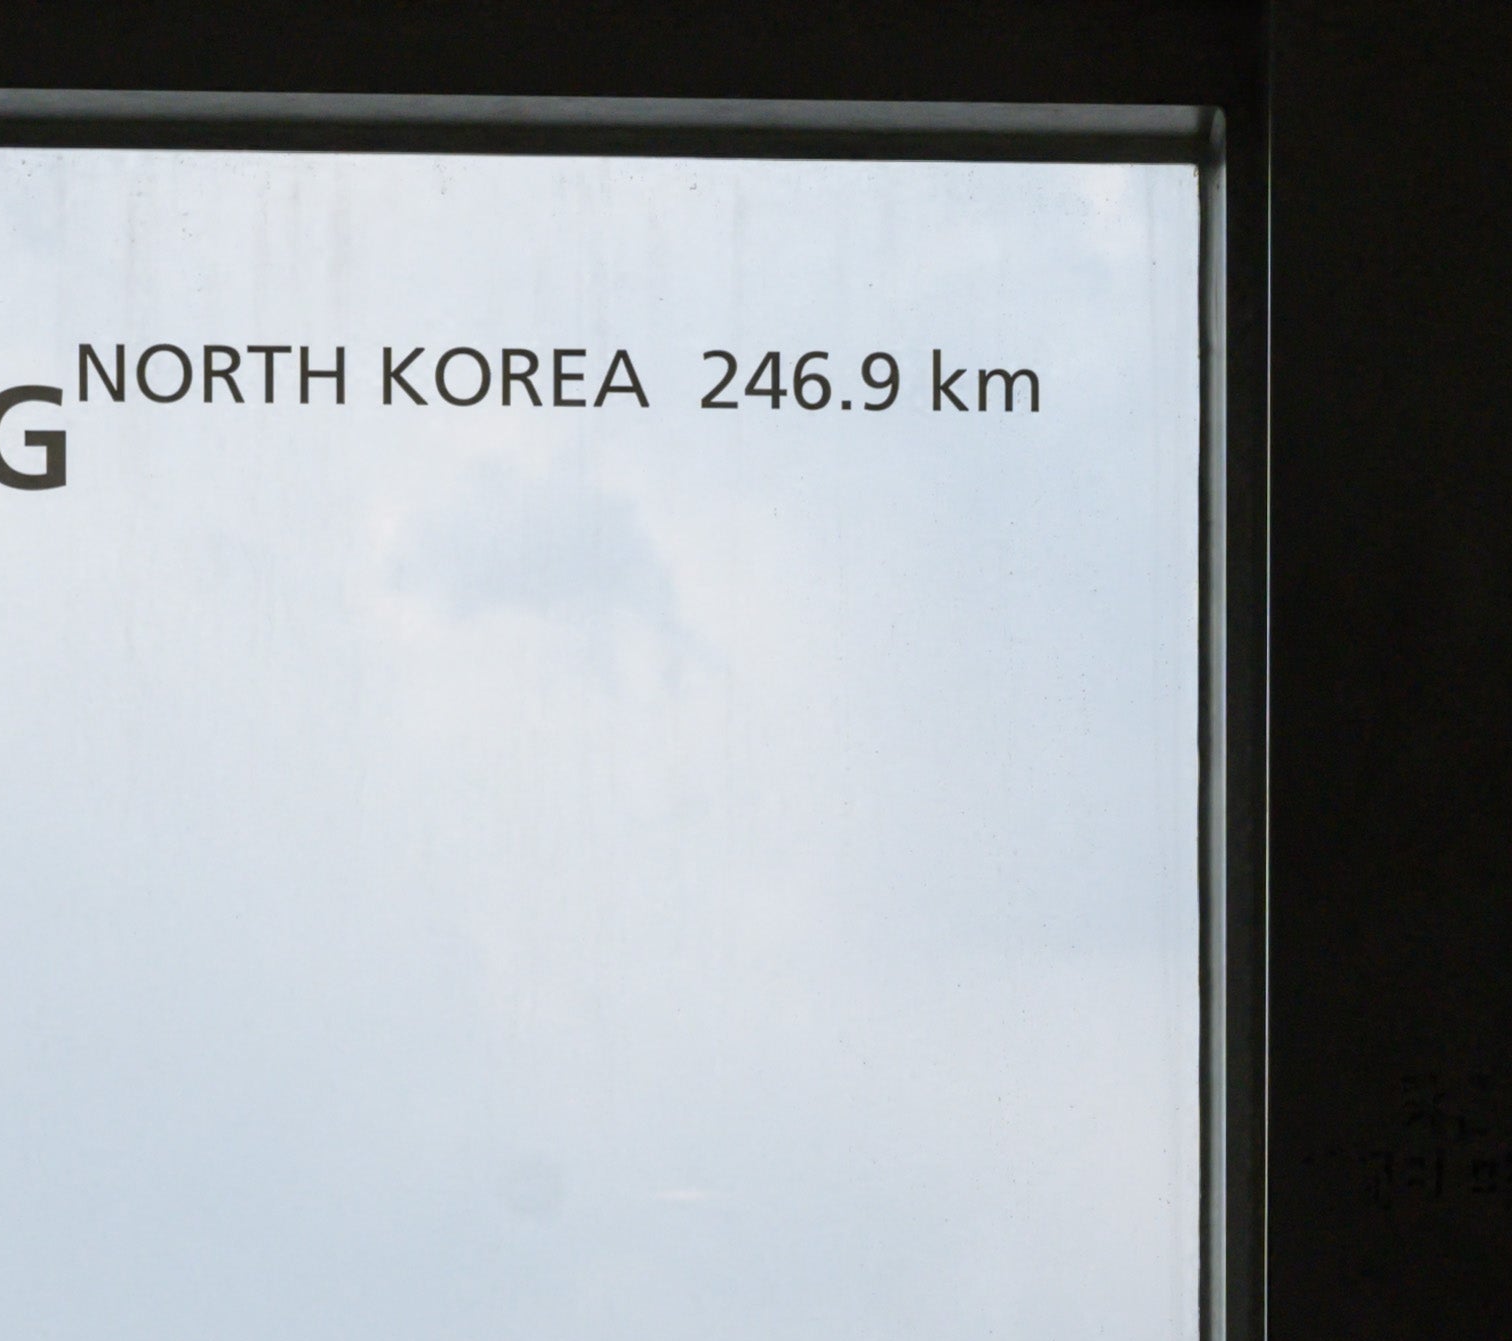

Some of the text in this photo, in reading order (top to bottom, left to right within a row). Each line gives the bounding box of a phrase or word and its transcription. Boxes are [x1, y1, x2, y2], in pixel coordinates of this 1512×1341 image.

[78, 343, 345, 405] NORTH
[382, 346, 650, 408] KOREA
[701, 349, 900, 412] 246.9
[932, 348, 1040, 413] km
